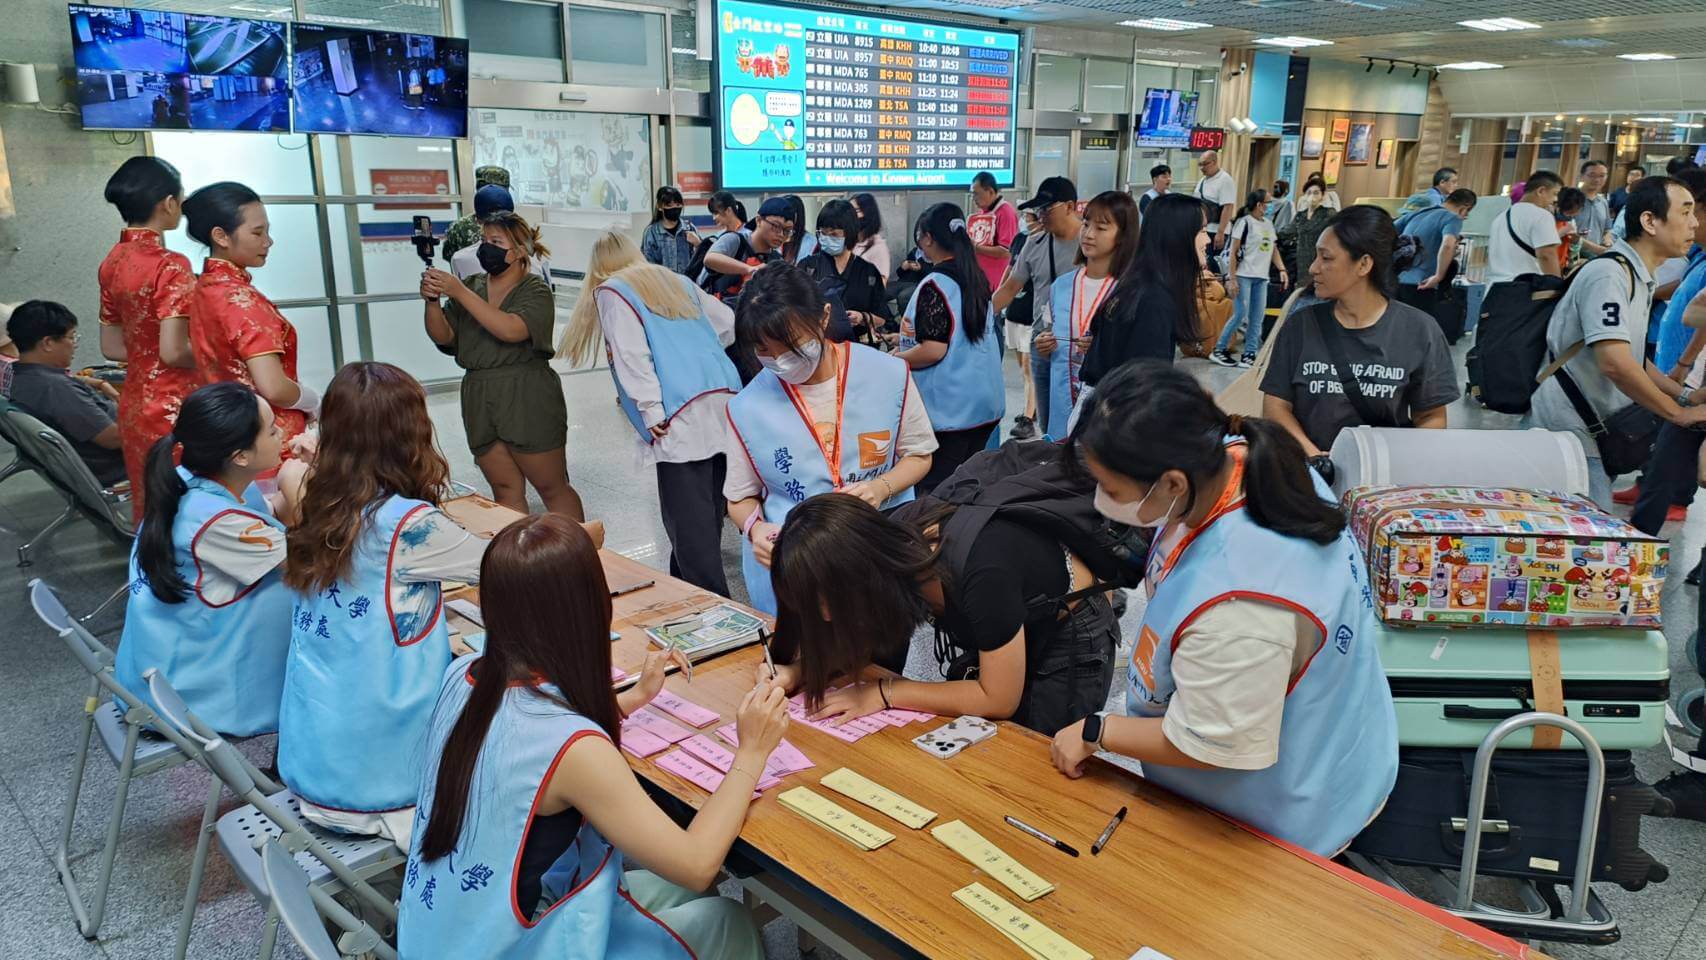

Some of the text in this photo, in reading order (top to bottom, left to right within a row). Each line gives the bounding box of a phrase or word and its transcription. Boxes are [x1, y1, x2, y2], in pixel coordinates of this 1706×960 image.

[834, 34, 849, 45] UIA
[855, 36, 873, 47] 8915
[896, 41, 912, 51] KHH
[834, 50, 848, 61] UIA
[855, 52, 873, 63] 8957
[896, 56, 913, 67] RMQ
[834, 65, 852, 77] MDA
[854, 67, 868, 78] 765
[896, 71, 912, 82] RMQ
[918, 72, 937, 83] 11:10
[941, 74, 959, 84] 11:02
[834, 81, 852, 92] MDA
[854, 82, 868, 94] 305
[895, 86, 911, 96] KHH
[918, 87, 936, 98] 11:25
[940, 88, 959, 99] 11:24
[834, 96, 852, 108] MDA
[854, 98, 873, 109] 1269
[895, 100, 908, 110] TSA
[834, 112, 848, 123] UIA
[895, 115, 908, 126] TSA
[917, 116, 936, 127] 11:50
[940, 117, 957, 128] 11:47
[834, 127, 852, 139] MDA
[854, 128, 868, 139] 763
[895, 130, 912, 141] RMQ
[917, 131, 936, 141] 12:10
[1193, 132, 1222, 148] 10:57
[834, 143, 848, 154] UIA
[854, 143, 872, 154] 8917
[895, 145, 911, 155] KHH
[939, 145, 956, 156] 12:25
[834, 158, 852, 169] MDA
[854, 158, 872, 169] 1267
[894, 159, 907, 168] TSA
[916, 158, 934, 169] 13:10
[826, 173, 868, 184] Welcome
[1603, 302, 1620, 327] 3
[1302, 361, 1329, 376] STOP
[1363, 364, 1405, 381] AFRAID
[1309, 380, 1325, 394] OF
[1359, 382, 1397, 399] HAPPY
[1528, 560, 1560, 573] Happy
